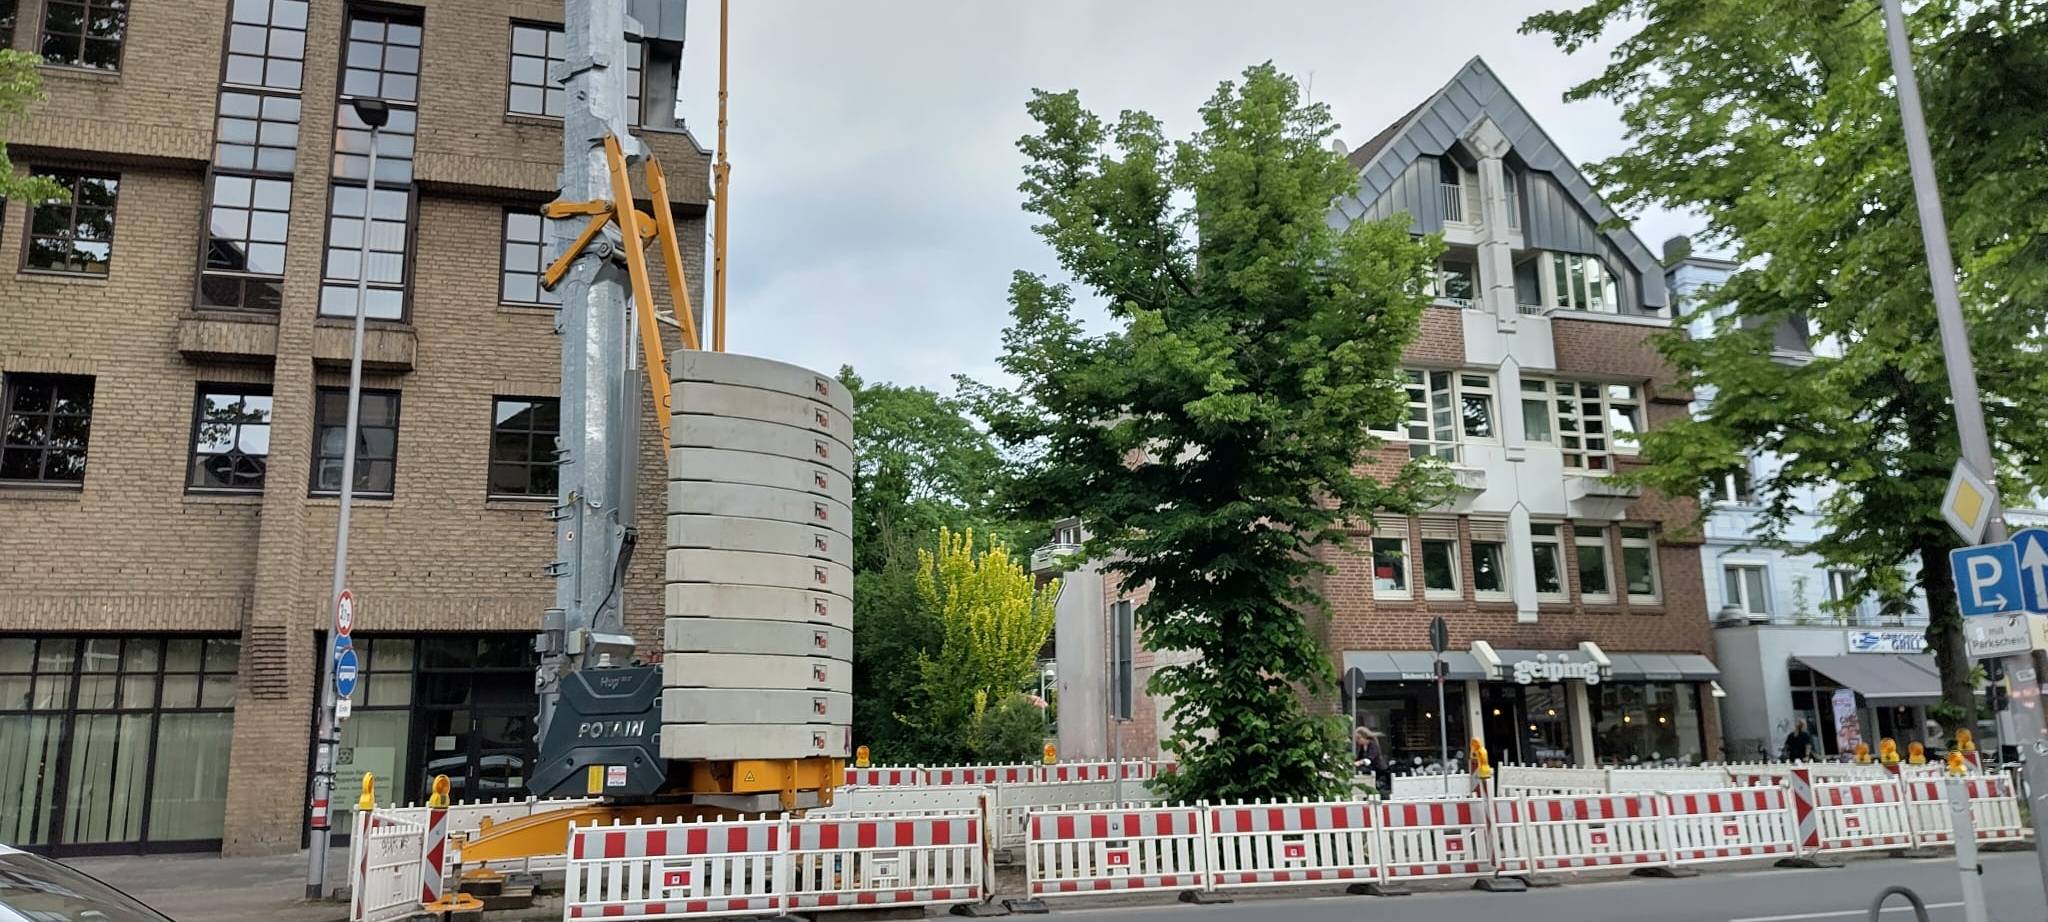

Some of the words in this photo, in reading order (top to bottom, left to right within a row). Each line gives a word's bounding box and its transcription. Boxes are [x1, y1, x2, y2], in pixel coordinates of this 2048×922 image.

[1967, 554, 2003, 608] P
[1972, 636, 2026, 649] Parkschein
[1513, 653, 1599, 685] geiping
[578, 720, 646, 738] POTAIN
